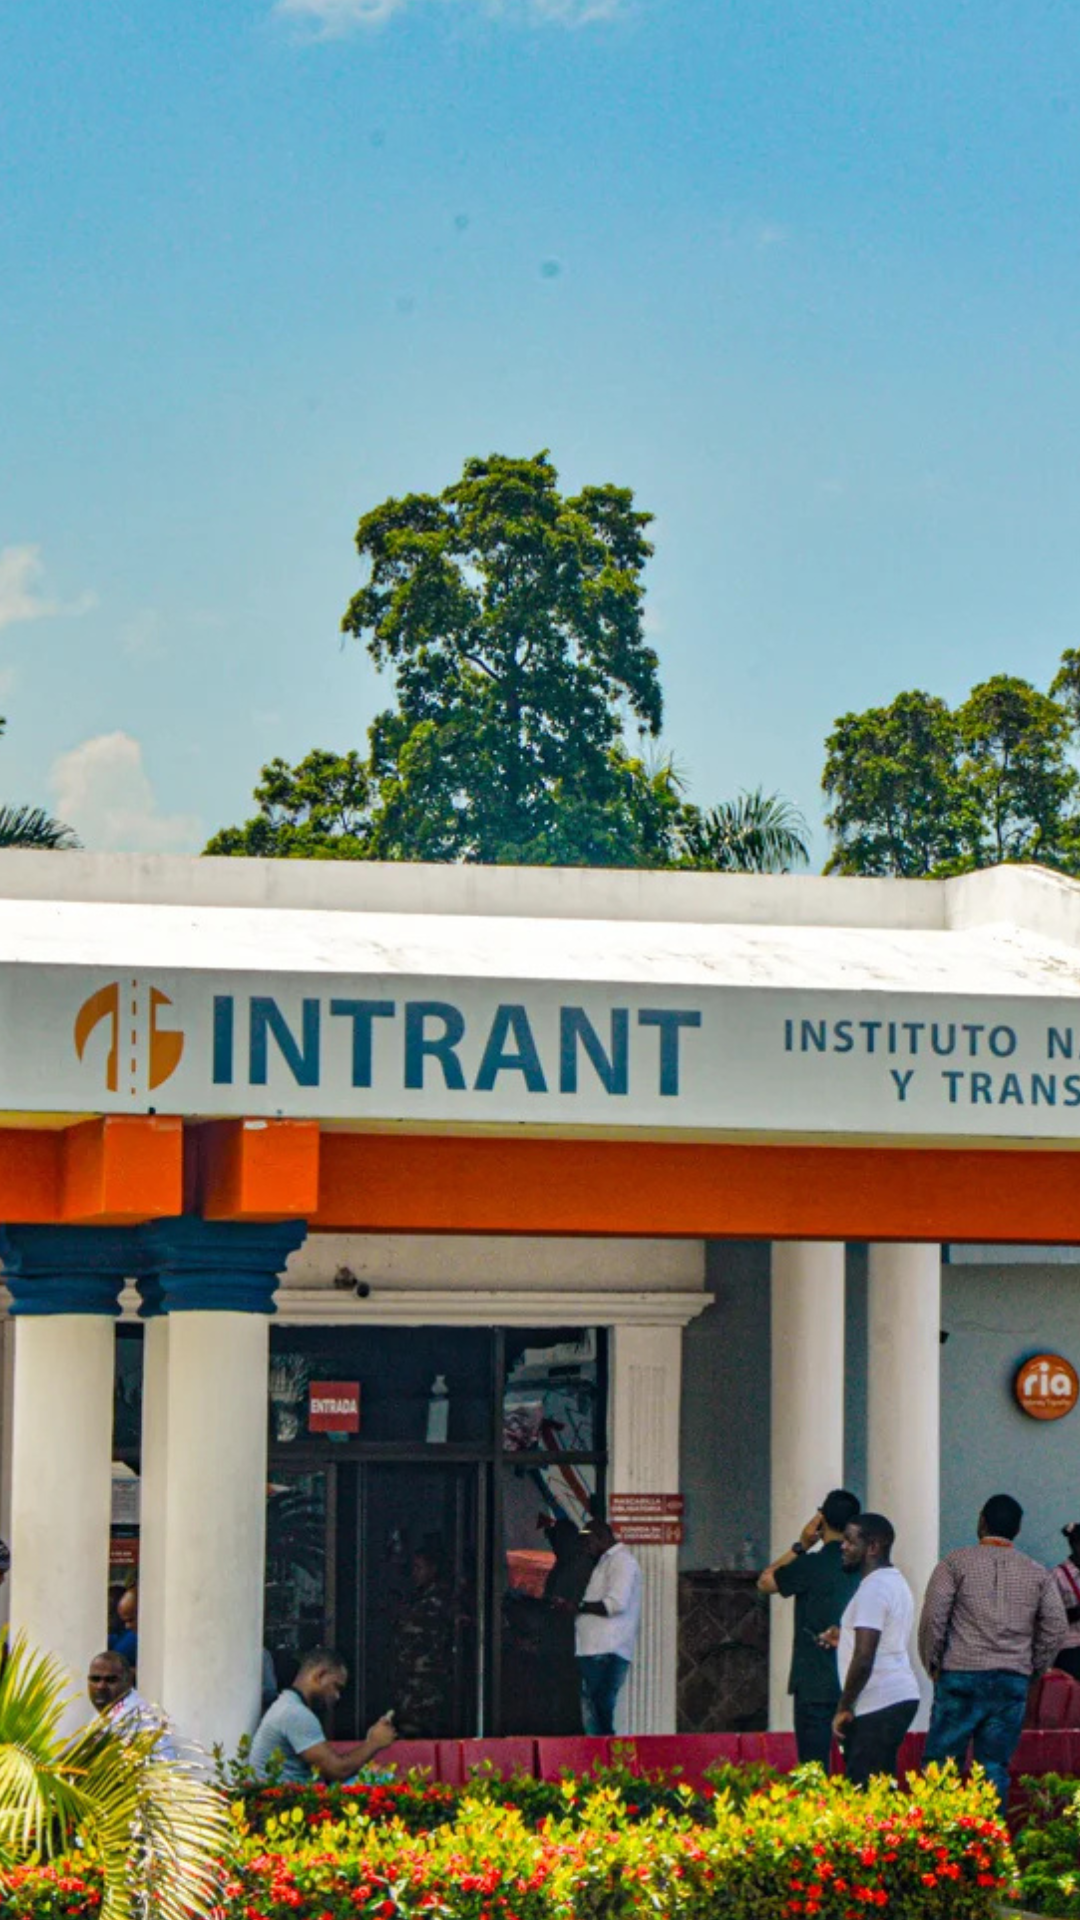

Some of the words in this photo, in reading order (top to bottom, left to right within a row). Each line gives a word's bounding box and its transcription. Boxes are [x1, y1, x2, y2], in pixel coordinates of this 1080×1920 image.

[212, 995, 702, 1096] INTRANT
[784, 1019, 1018, 1058] INSTITUTO
[1047, 1026, 1080, 1059] N
[889, 1069, 915, 1102] Y
[941, 1071, 1080, 1107] TRANS
[1023, 1362, 1072, 1396] ria
[310, 1398, 358, 1414] ENTRADA
